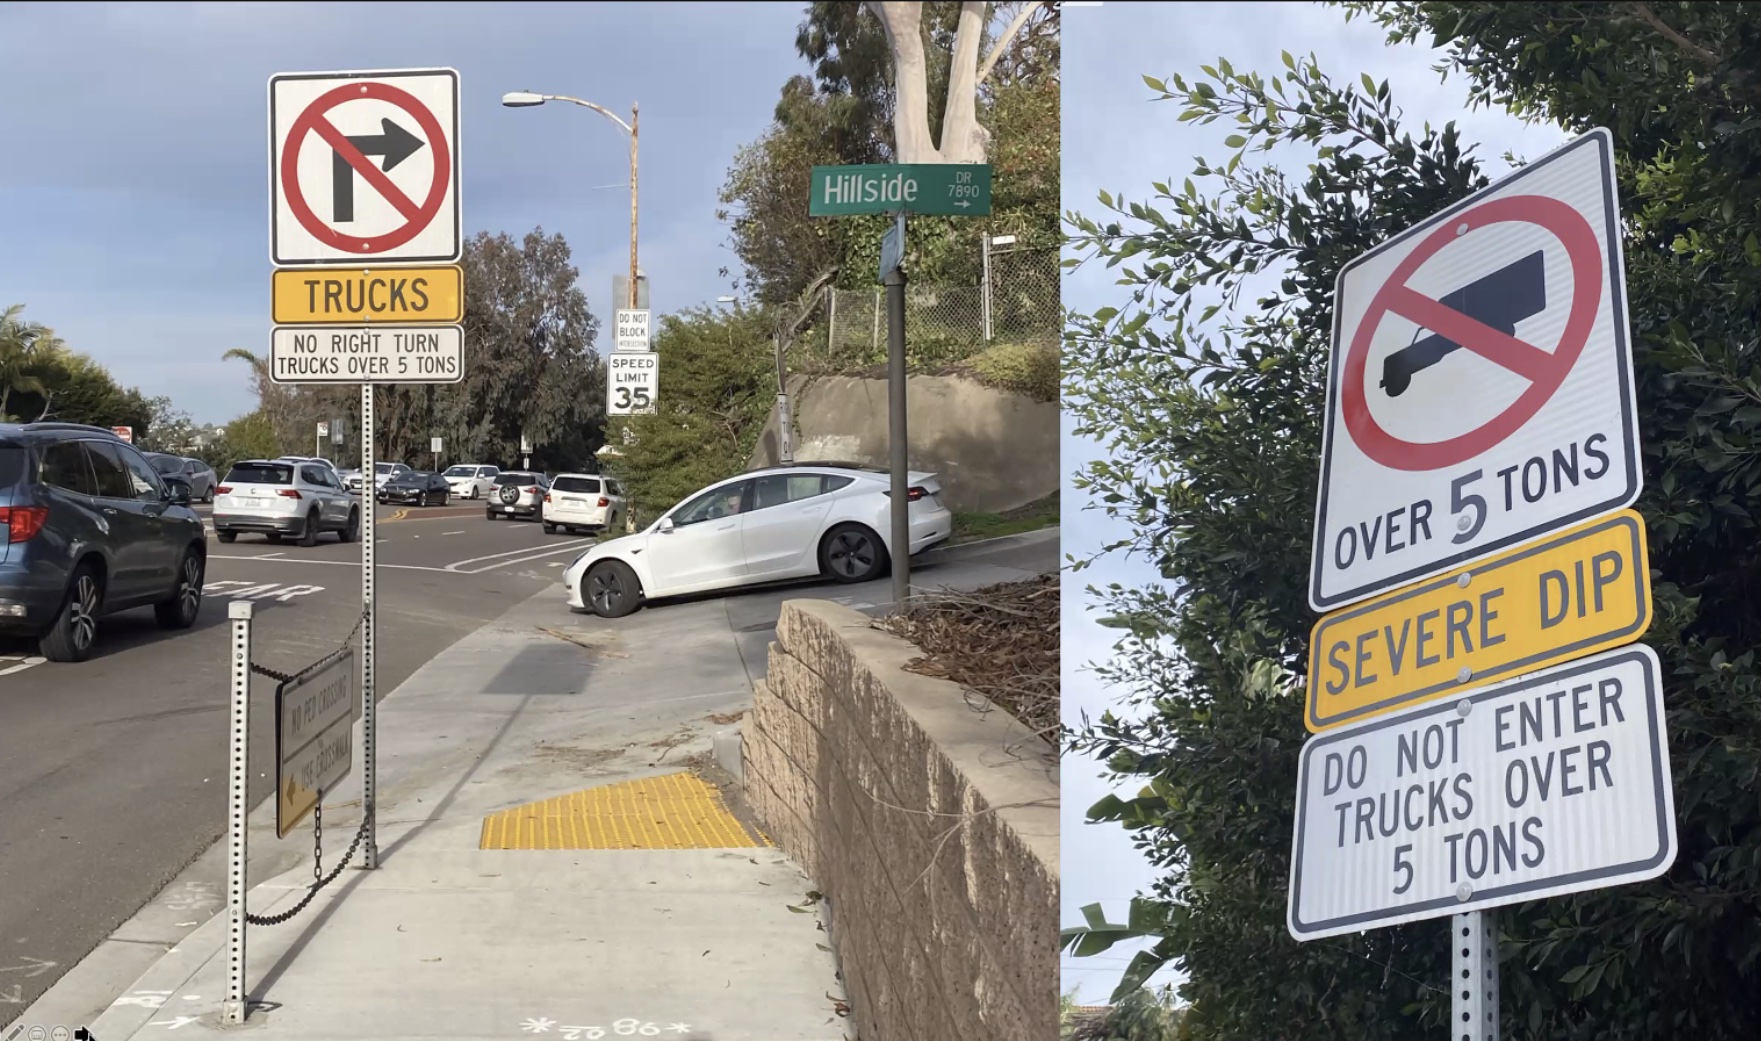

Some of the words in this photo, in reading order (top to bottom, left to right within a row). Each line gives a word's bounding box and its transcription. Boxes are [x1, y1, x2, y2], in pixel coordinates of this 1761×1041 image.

[824, 173, 918, 204] Hillside
[956, 171, 972, 184] DR
[948, 185, 980, 198] 7890
[304, 278, 429, 313] TRUCKS
[619, 313, 629, 323] DO
[632, 313, 647, 323] NOT
[294, 335, 317, 353] NO
[331, 334, 381, 353] RIGHT
[394, 334, 439, 353] TURN
[619, 327, 646, 337] BLOCK
[278, 357, 339, 374] TRUCKS
[348, 357, 389, 374] OVER
[398, 357, 408, 374] 5
[416, 356, 456, 373] TONS
[612, 359, 654, 368] SPEED
[616, 373, 649, 382] LIMIT
[614, 386, 650, 409] 35
[1335, 499, 1433, 571] OVER
[1450, 468, 1488, 545] 5
[1496, 432, 1611, 512] TONS
[1325, 587, 1506, 696] SEVERE
[1539, 550, 1623, 630] DIP
[1323, 745, 1368, 797] DO
[1396, 717, 1465, 778] NOT
[1495, 677, 1626, 753] ENTER
[1334, 772, 1473, 848] TRUCKS
[1505, 740, 1614, 809] OVER
[1392, 844, 1414, 894] 5
[1443, 816, 1545, 884] TONS
